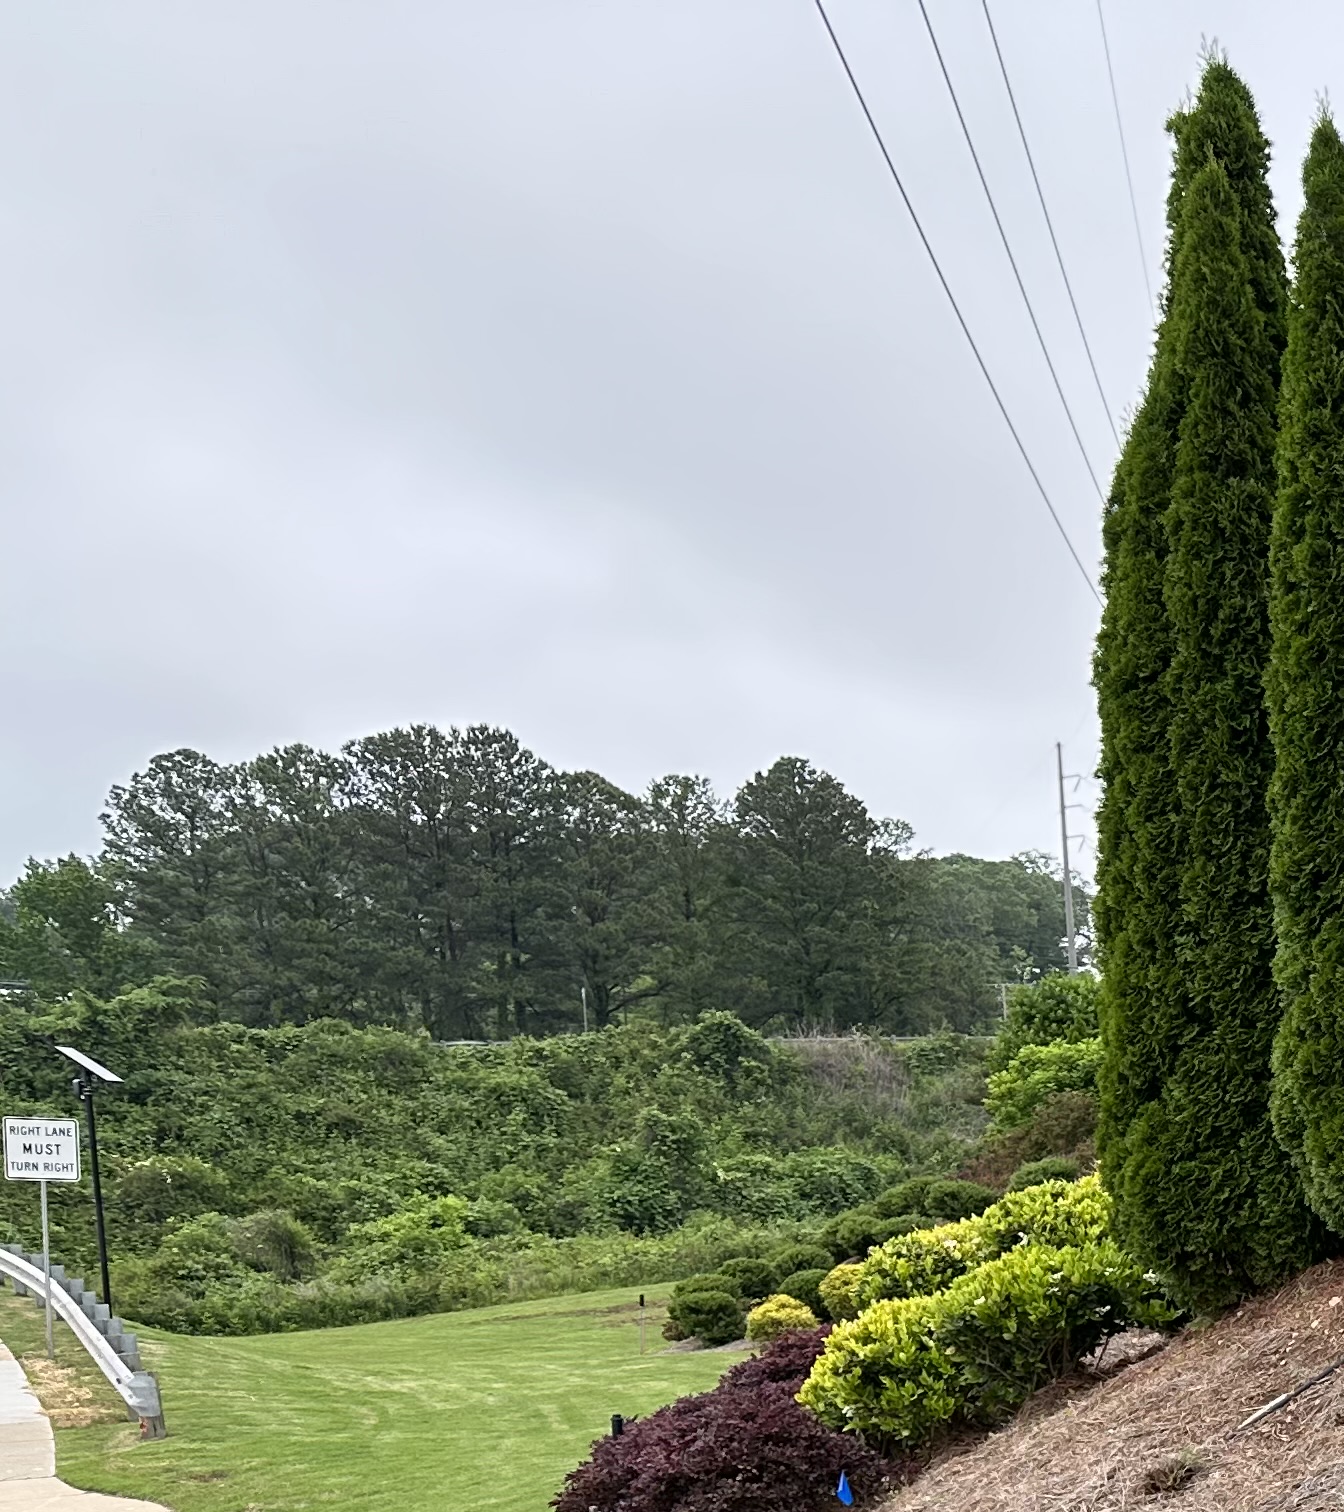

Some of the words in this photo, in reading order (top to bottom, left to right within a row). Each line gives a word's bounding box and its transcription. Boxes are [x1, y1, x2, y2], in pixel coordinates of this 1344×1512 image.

[9, 1126, 41, 1136] RIGHT
[45, 1127, 73, 1137] LANE
[23, 1143, 61, 1155] MUST
[11, 1161, 39, 1171] TURN
[43, 1163, 74, 1172] RIGHT
